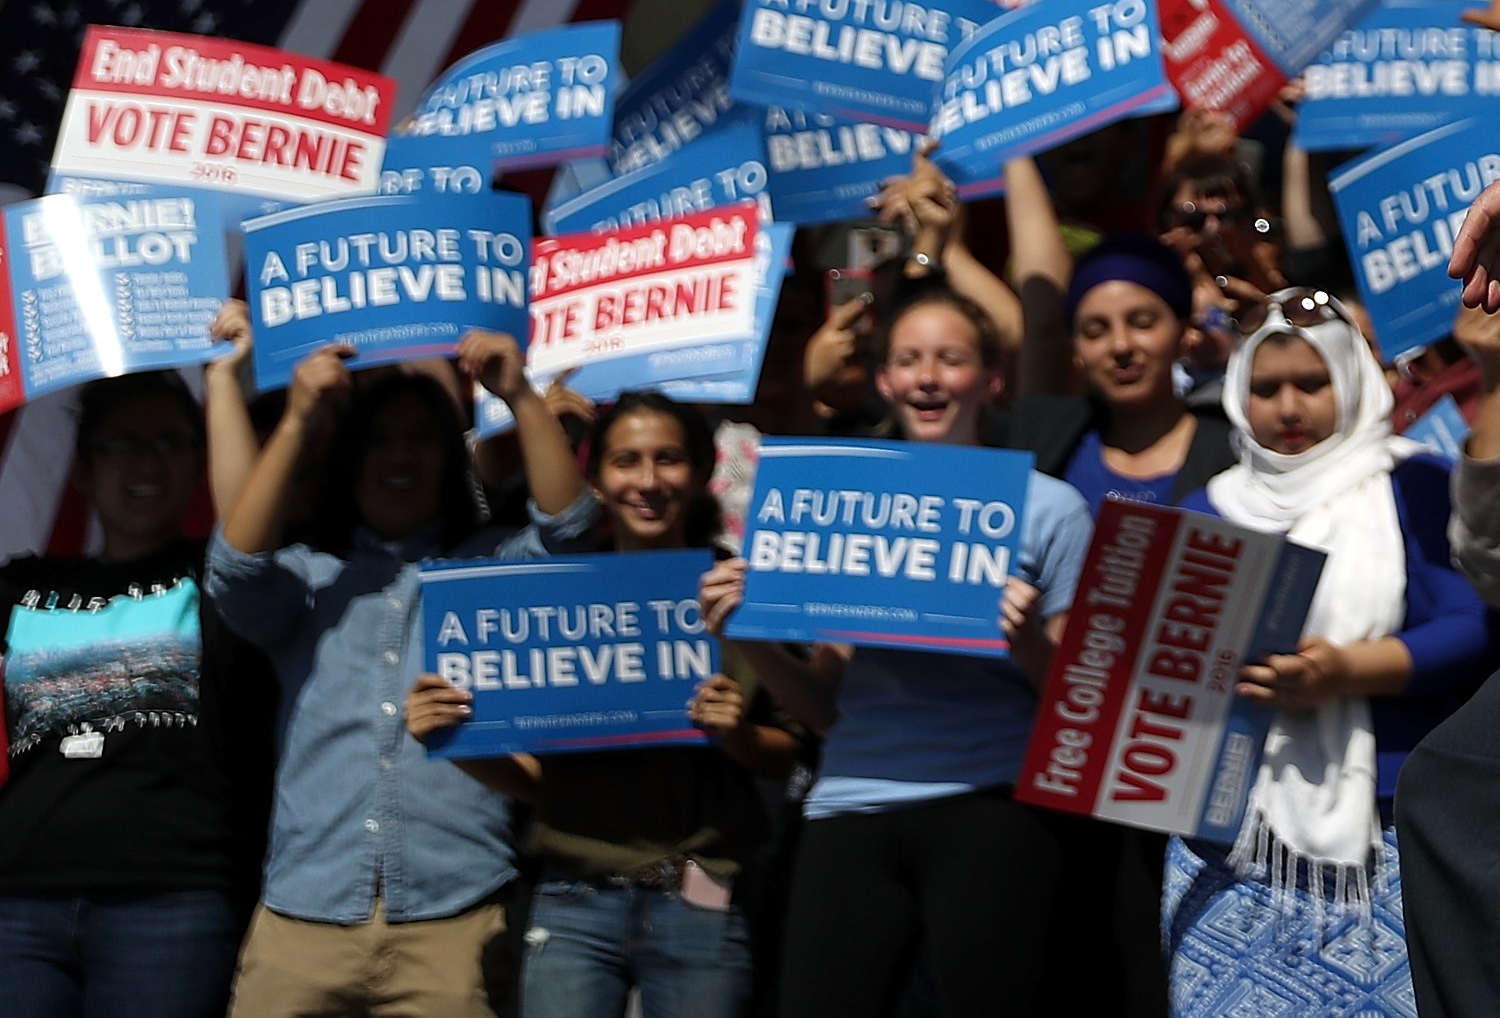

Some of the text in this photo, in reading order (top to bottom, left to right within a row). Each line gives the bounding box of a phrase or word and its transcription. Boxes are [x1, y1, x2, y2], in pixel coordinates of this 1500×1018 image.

[557, 54, 608, 86] TO
[752, 8, 948, 81] BELIEVE
[92, 38, 381, 125] End Student Debt
[556, 83, 606, 120] IN
[928, 45, 1092, 142] ELIEVE
[1096, 23, 1150, 71] IN
[1304, 60, 1470, 100] BELIEVE
[86, 101, 198, 153] VOTE
[205, 114, 367, 182] BERNIE
[717, 161, 768, 200] TO
[260, 229, 523, 286] A FUTURE TO
[551, 230, 667, 291] Student
[669, 215, 747, 264] Debt
[1357, 211, 1383, 248] A
[260, 264, 467, 328] BELIEVE
[475, 264, 525, 309] IN
[593, 272, 739, 332] BERNIE
[757, 488, 1016, 539] A FUTURE TO
[750, 529, 1012, 588] BELIEVE IN
[437, 598, 706, 648] A FUTURE TO
[437, 639, 712, 692] BELIEVE IN
[1033, 513, 1157, 797] Free College Tuition
[1110, 526, 1246, 804] VOTE BERNIE
